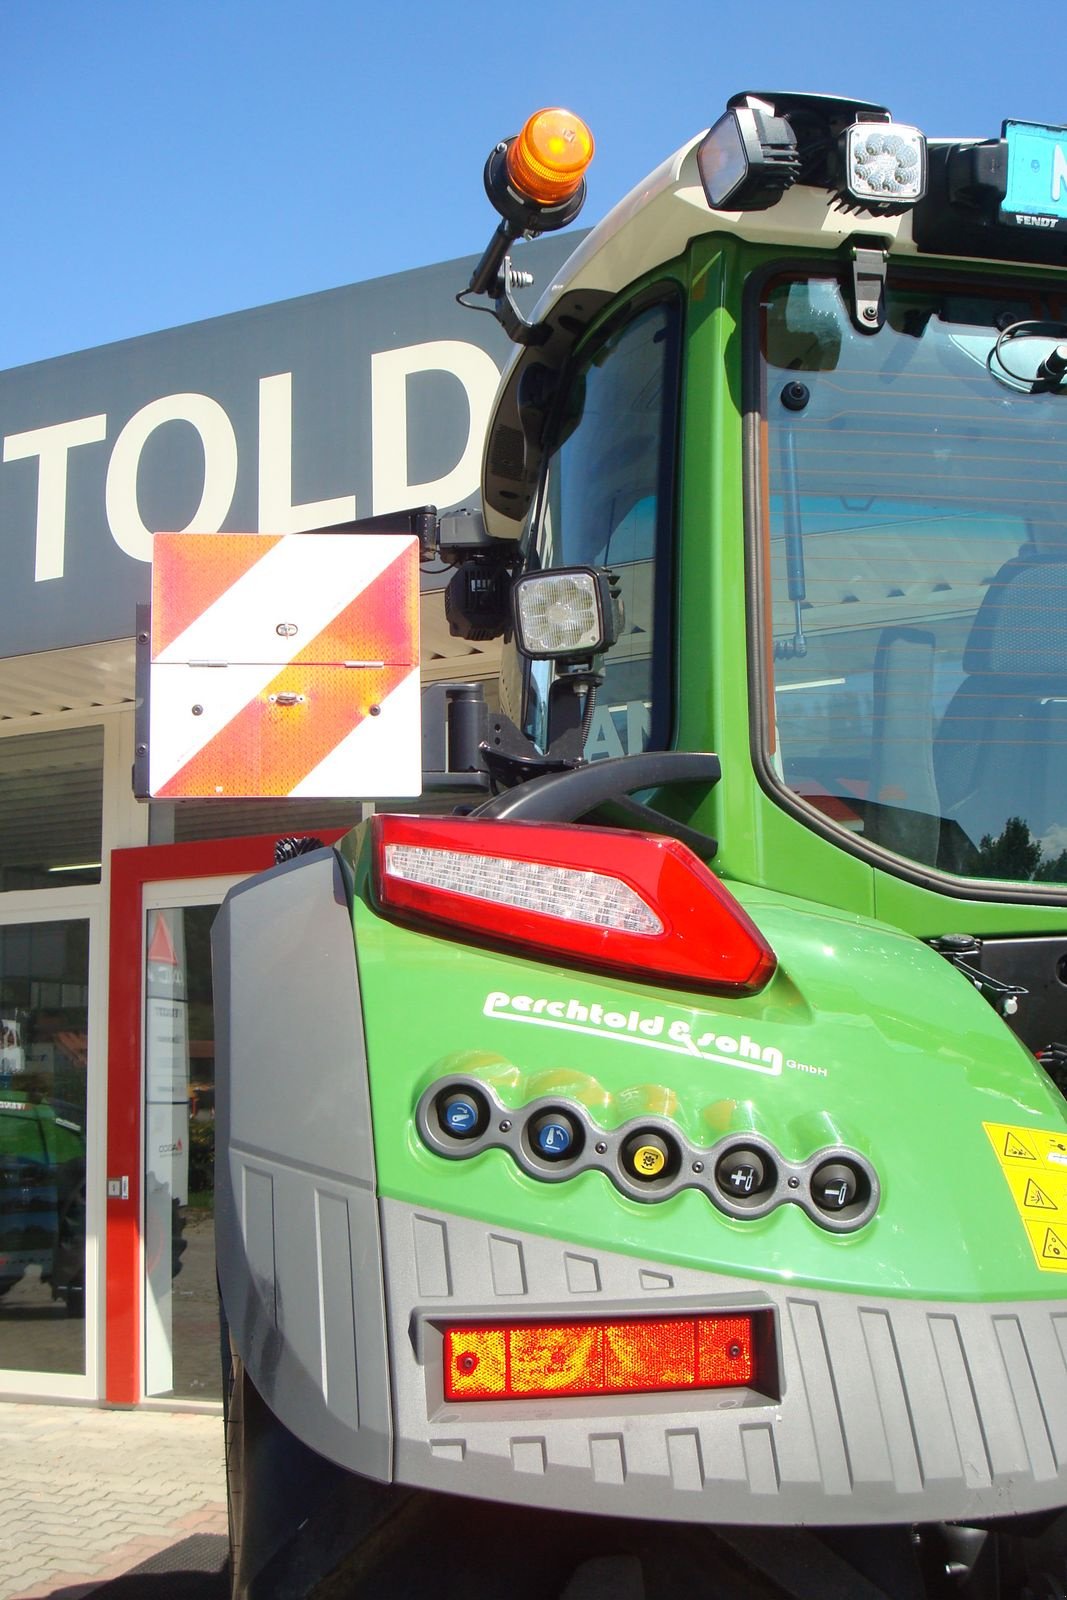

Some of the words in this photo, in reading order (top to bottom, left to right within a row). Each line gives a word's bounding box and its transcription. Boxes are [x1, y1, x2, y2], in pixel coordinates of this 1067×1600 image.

[1015, 214, 1059, 228] FENDT
[3, 340, 501, 582] TOLD
[483, 991, 665, 1036] perchtold
[668, 1020, 698, 1052] &
[697, 1032, 783, 1076] sohn
[786, 1059, 828, 1077] GmbH
